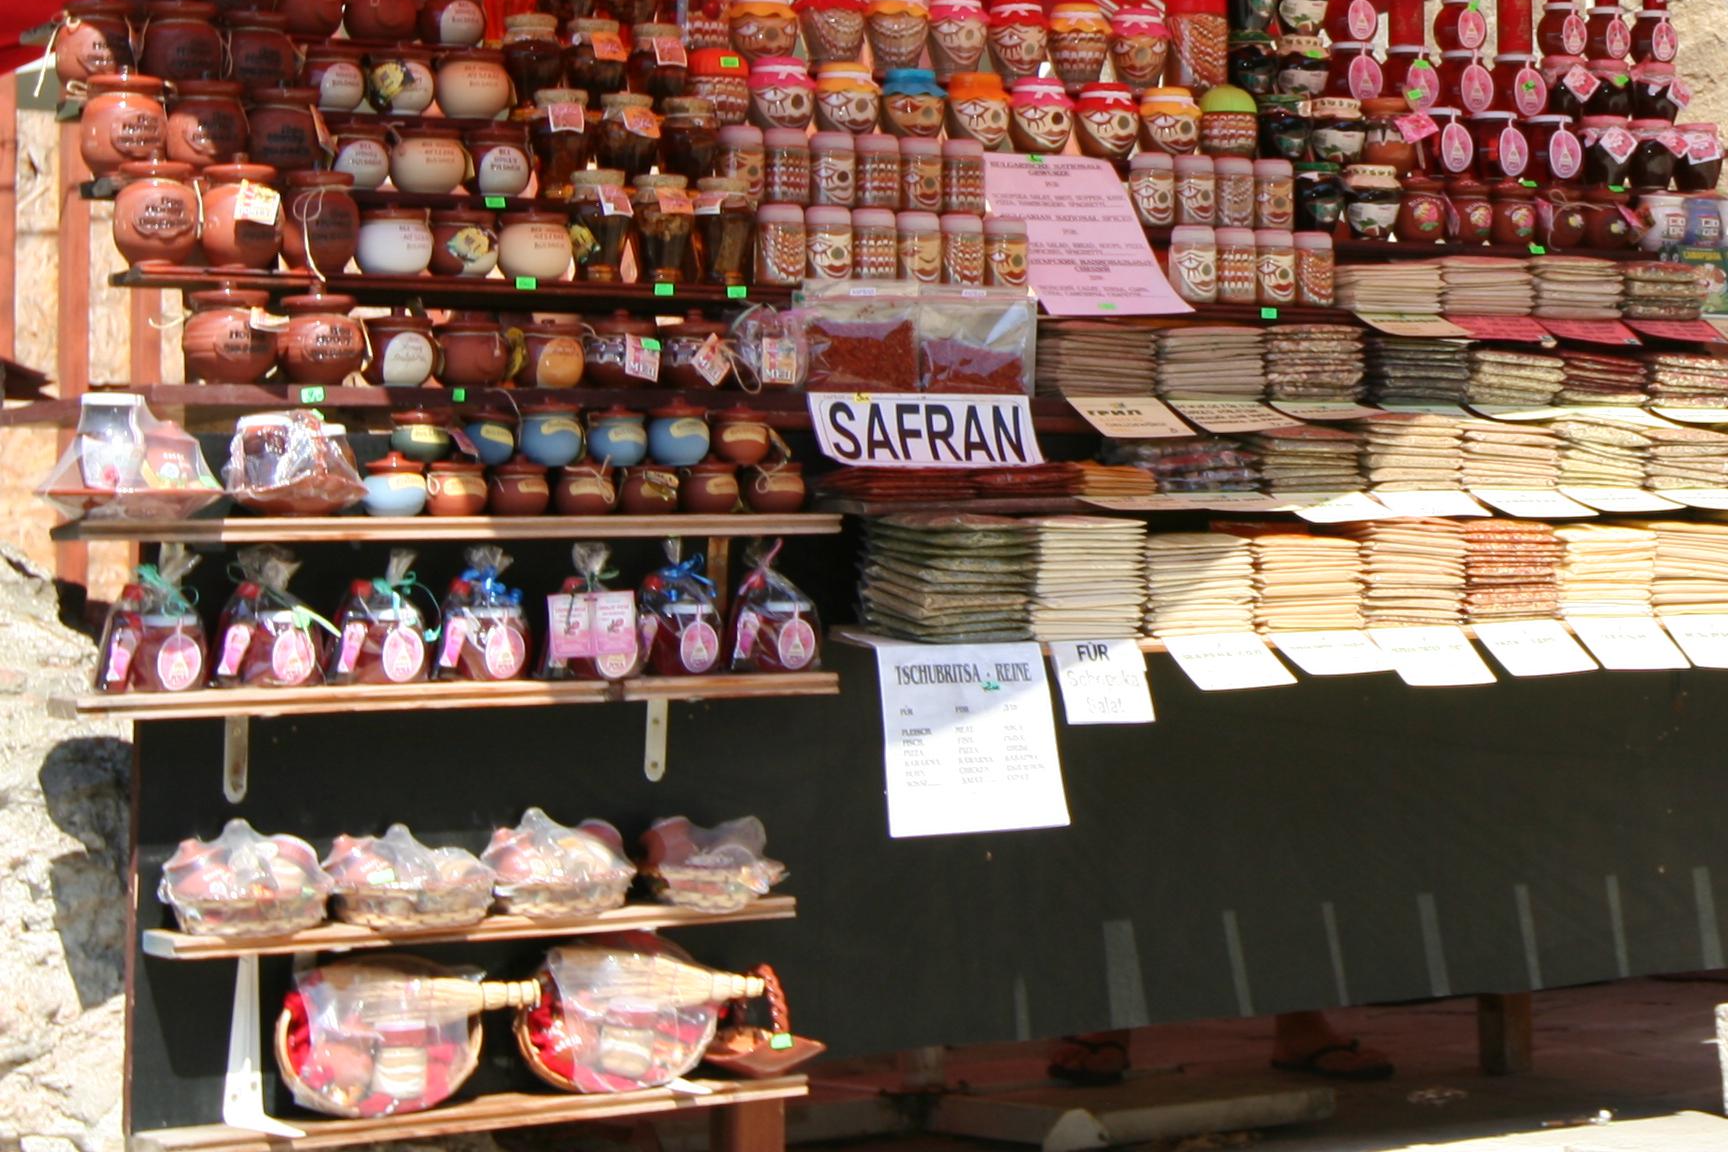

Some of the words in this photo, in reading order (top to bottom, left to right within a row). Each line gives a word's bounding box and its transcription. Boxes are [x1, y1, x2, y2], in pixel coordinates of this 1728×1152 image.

[828, 401, 1028, 463] SAFRAN
[894, 663, 981, 685] TSCHUBRITSA
[995, 662, 1033, 682] REINE
